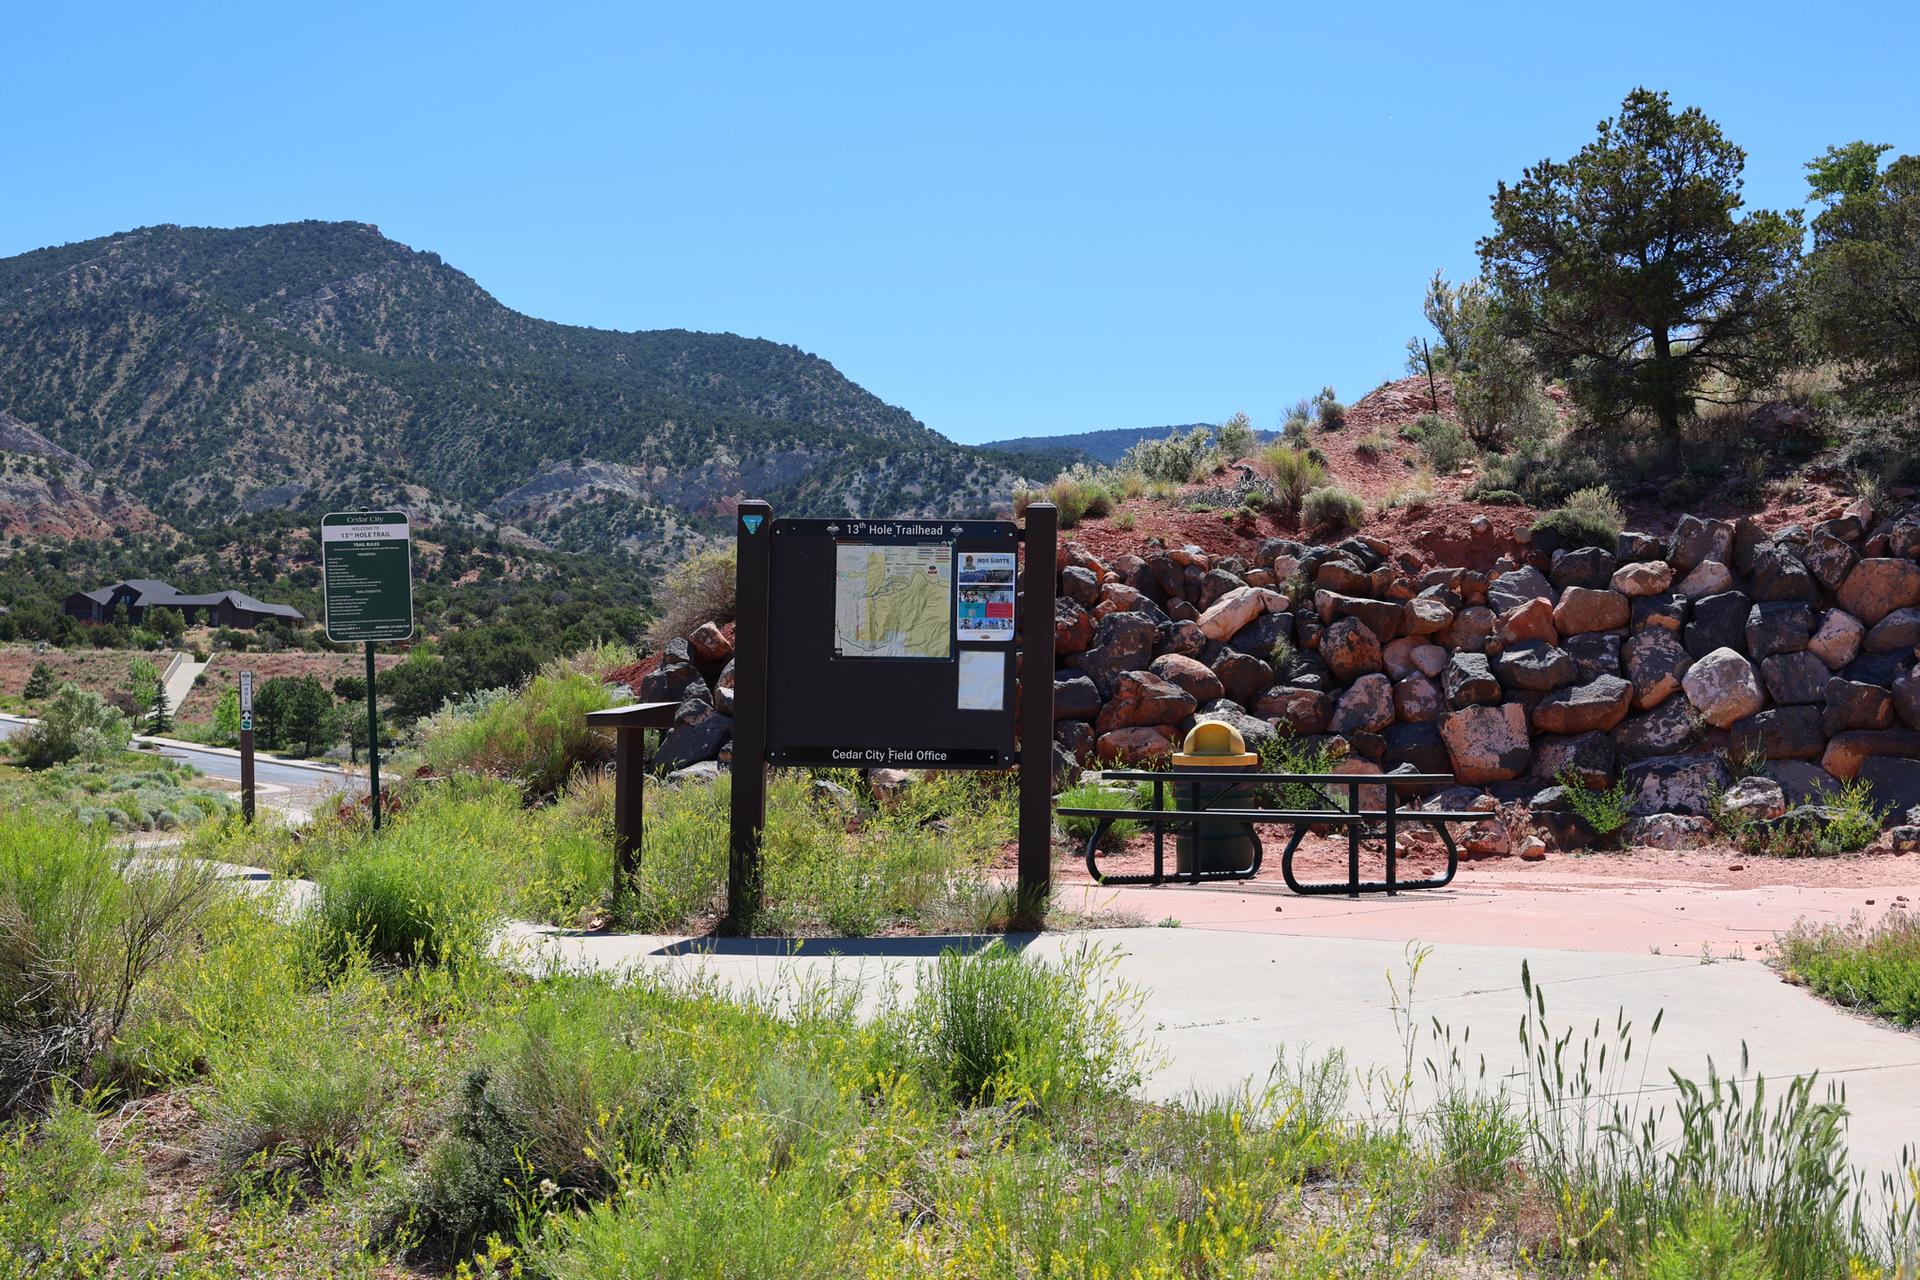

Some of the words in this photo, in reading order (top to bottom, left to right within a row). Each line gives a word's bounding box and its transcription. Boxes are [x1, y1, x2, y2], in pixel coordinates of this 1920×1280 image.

[847, 522, 867, 535] 13th
[869, 524, 893, 535] Hole
[895, 525, 943, 535] Trailhead
[832, 749, 863, 760] Cedar
[865, 749, 885, 762] City
[888, 750, 913, 760] Field
[916, 750, 947, 761] Office
